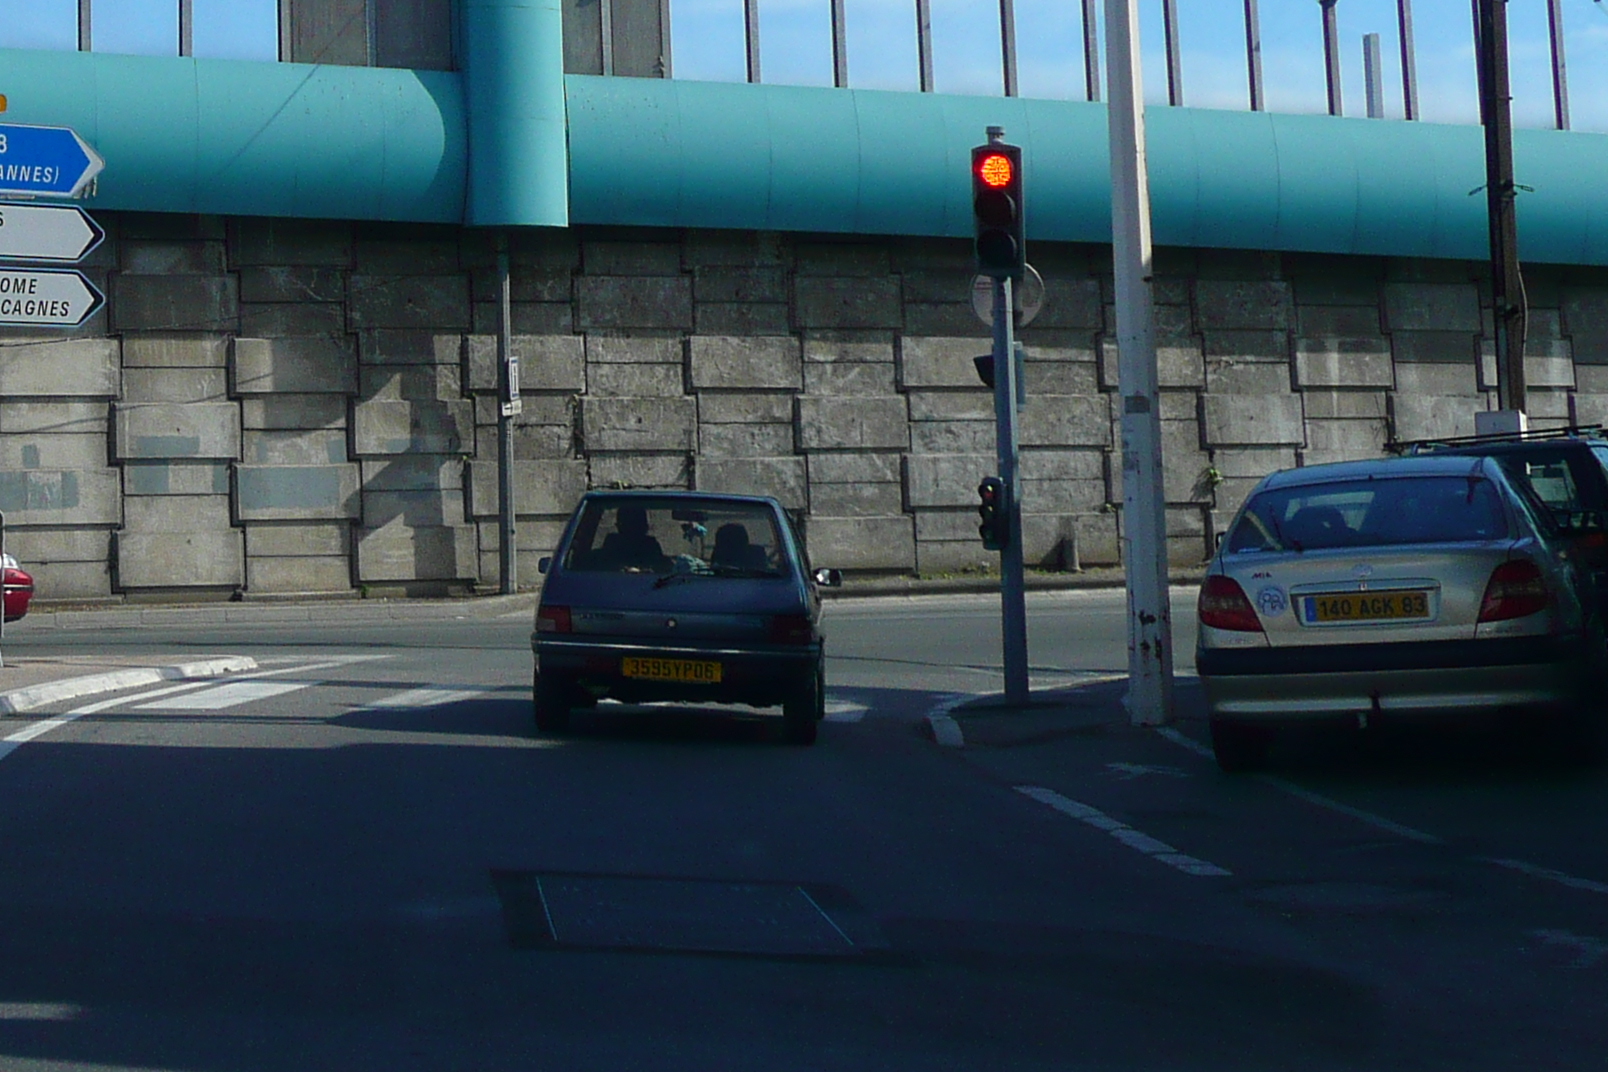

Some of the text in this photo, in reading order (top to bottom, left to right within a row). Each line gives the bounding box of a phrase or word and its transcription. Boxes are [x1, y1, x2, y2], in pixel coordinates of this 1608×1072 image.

[1, 299, 69, 316] CAGNES
[1320, 596, 1425, 617] 140 AGK 83
